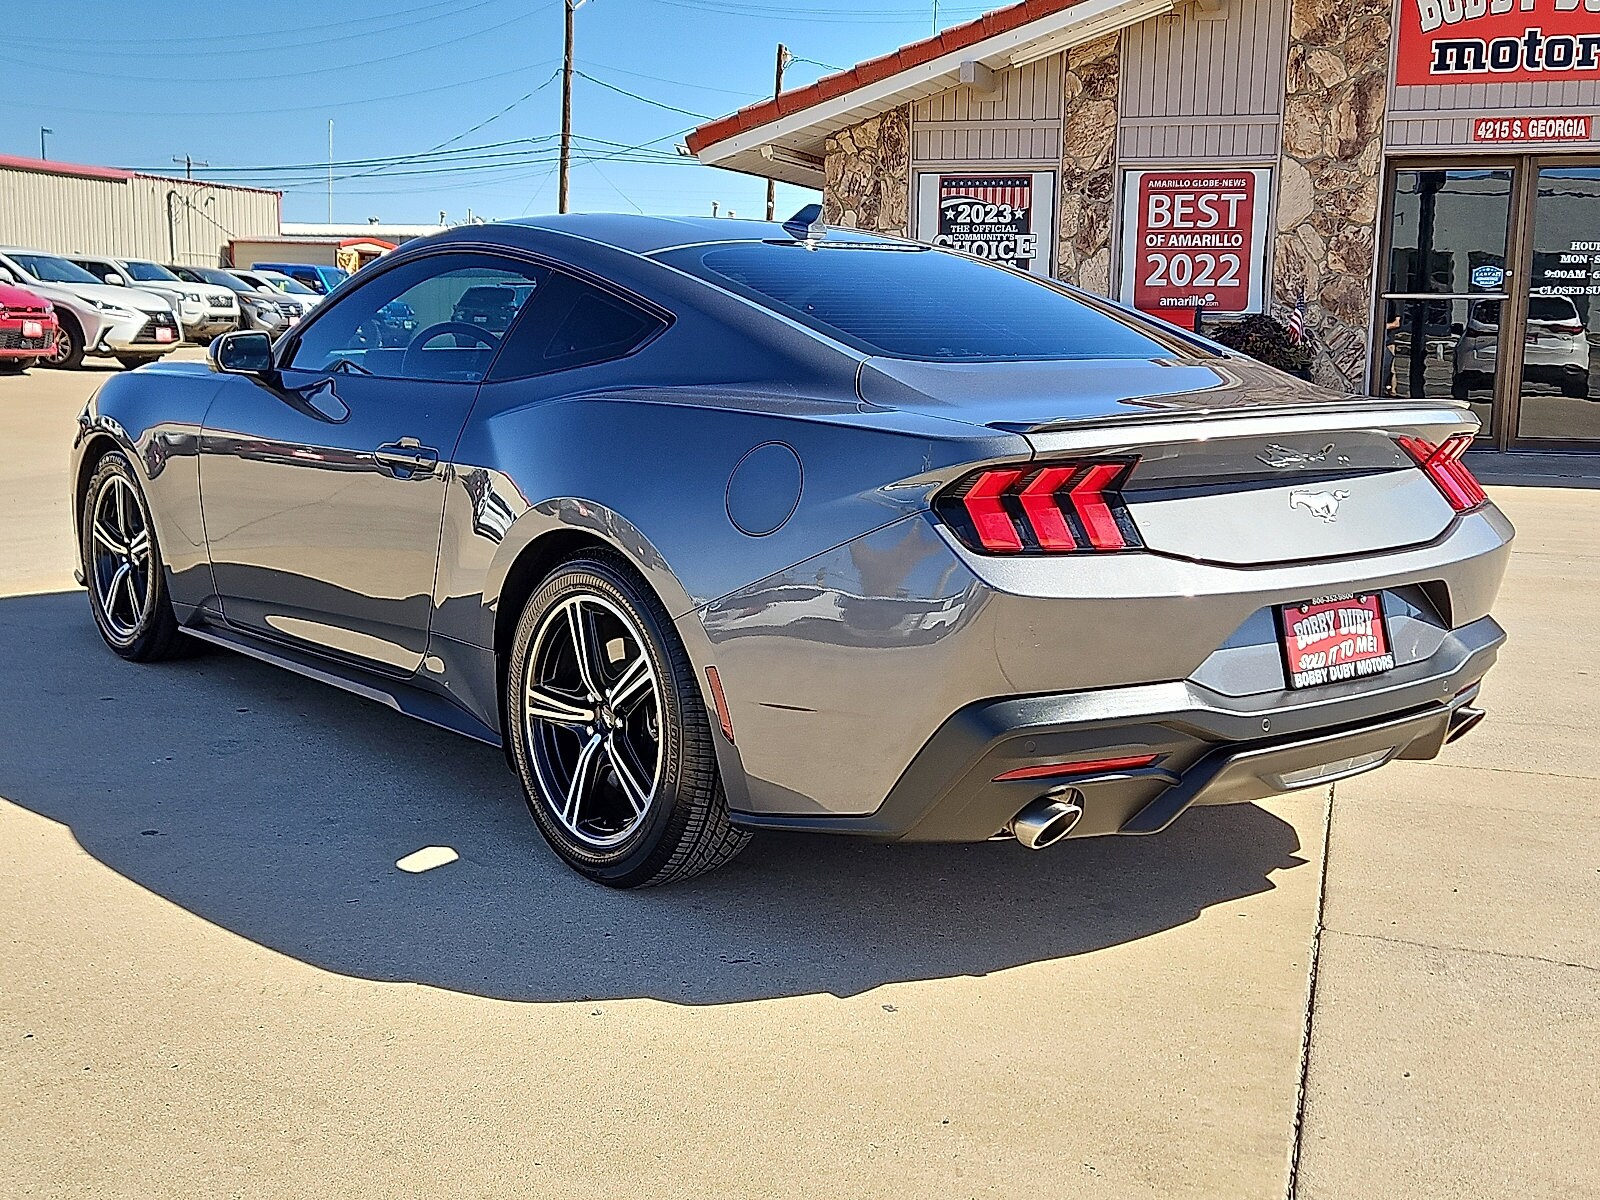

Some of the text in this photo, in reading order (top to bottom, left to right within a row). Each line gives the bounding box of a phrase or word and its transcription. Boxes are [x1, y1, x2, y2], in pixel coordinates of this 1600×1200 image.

[1477, 119, 1586, 138] 4215 S. GEORGIA
[1148, 179, 1246, 188] AMARILLO GLOBE-NEWS
[957, 204, 1012, 223] 2023
[1147, 193, 1247, 228] BEST
[972, 225, 1018, 233] OFFICIAL
[1145, 233, 1243, 247] OF AMARILLO
[1144, 253, 1241, 287] 2022
[1540, 286, 1584, 294] CLOSED
[1293, 608, 1374, 650] BOBBY DUBY
[1299, 652, 1327, 669] SOLD
[1328, 645, 1340, 666] IT
[1340, 638, 1354, 660] TO
[1294, 655, 1394, 688] BOBBY DUBY MOTORS
